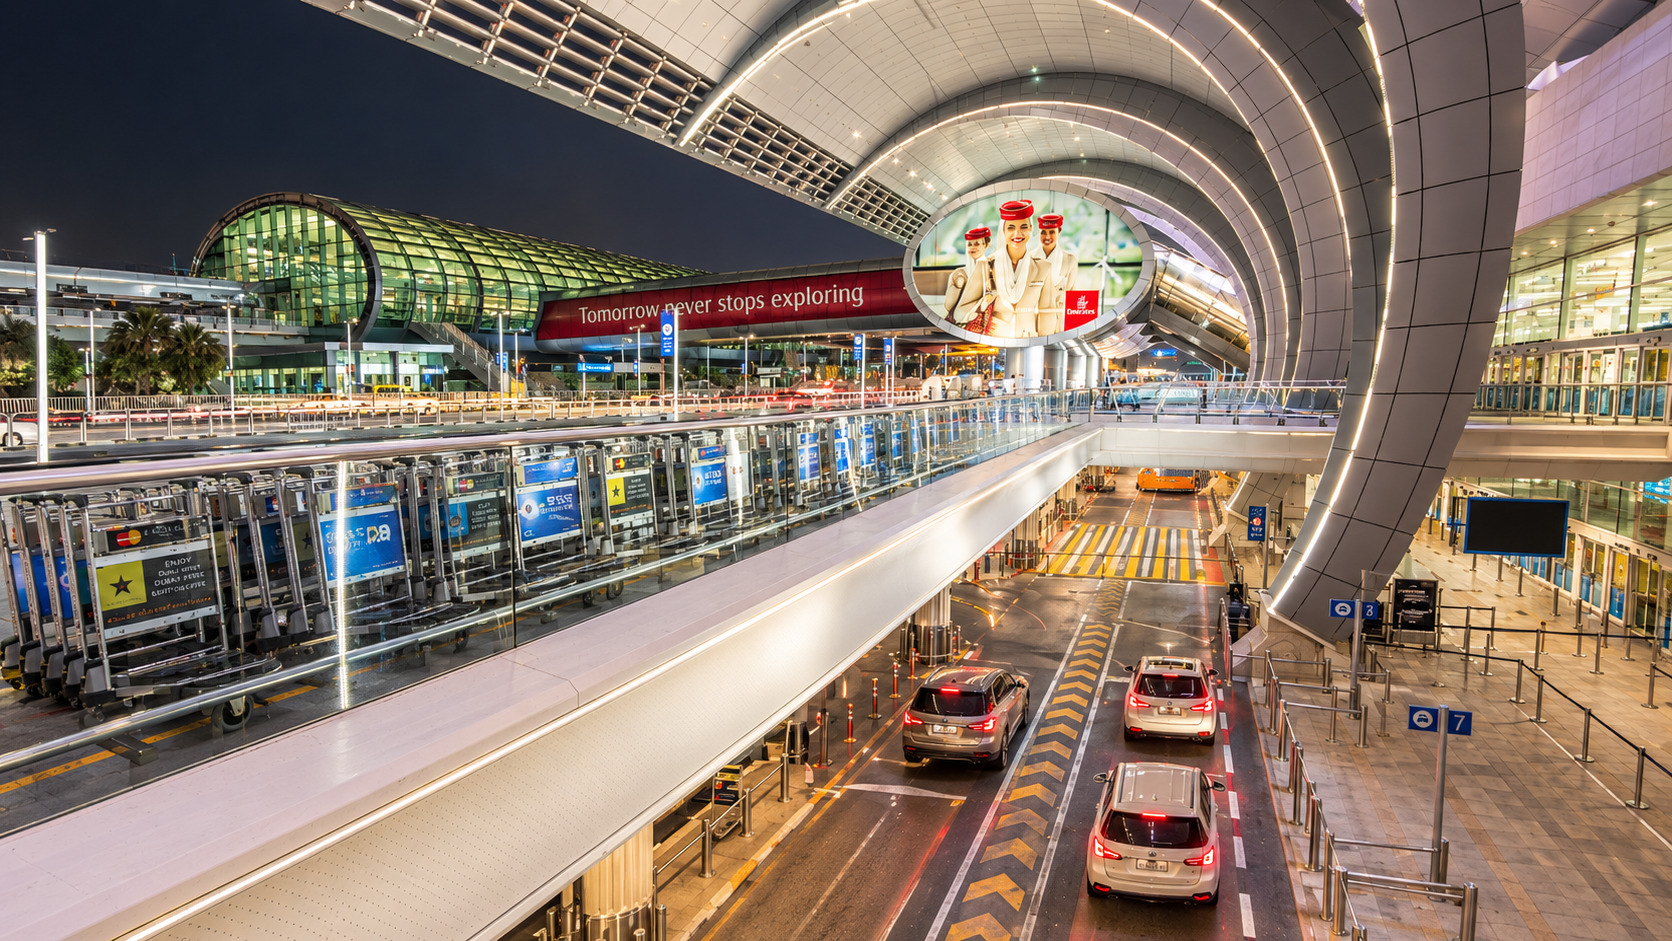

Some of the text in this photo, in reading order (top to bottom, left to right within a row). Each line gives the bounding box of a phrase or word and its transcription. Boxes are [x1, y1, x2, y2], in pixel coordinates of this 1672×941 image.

[578, 284, 864, 324] Tomorrow never stops exploring
[1453, 714, 1466, 731] 7
